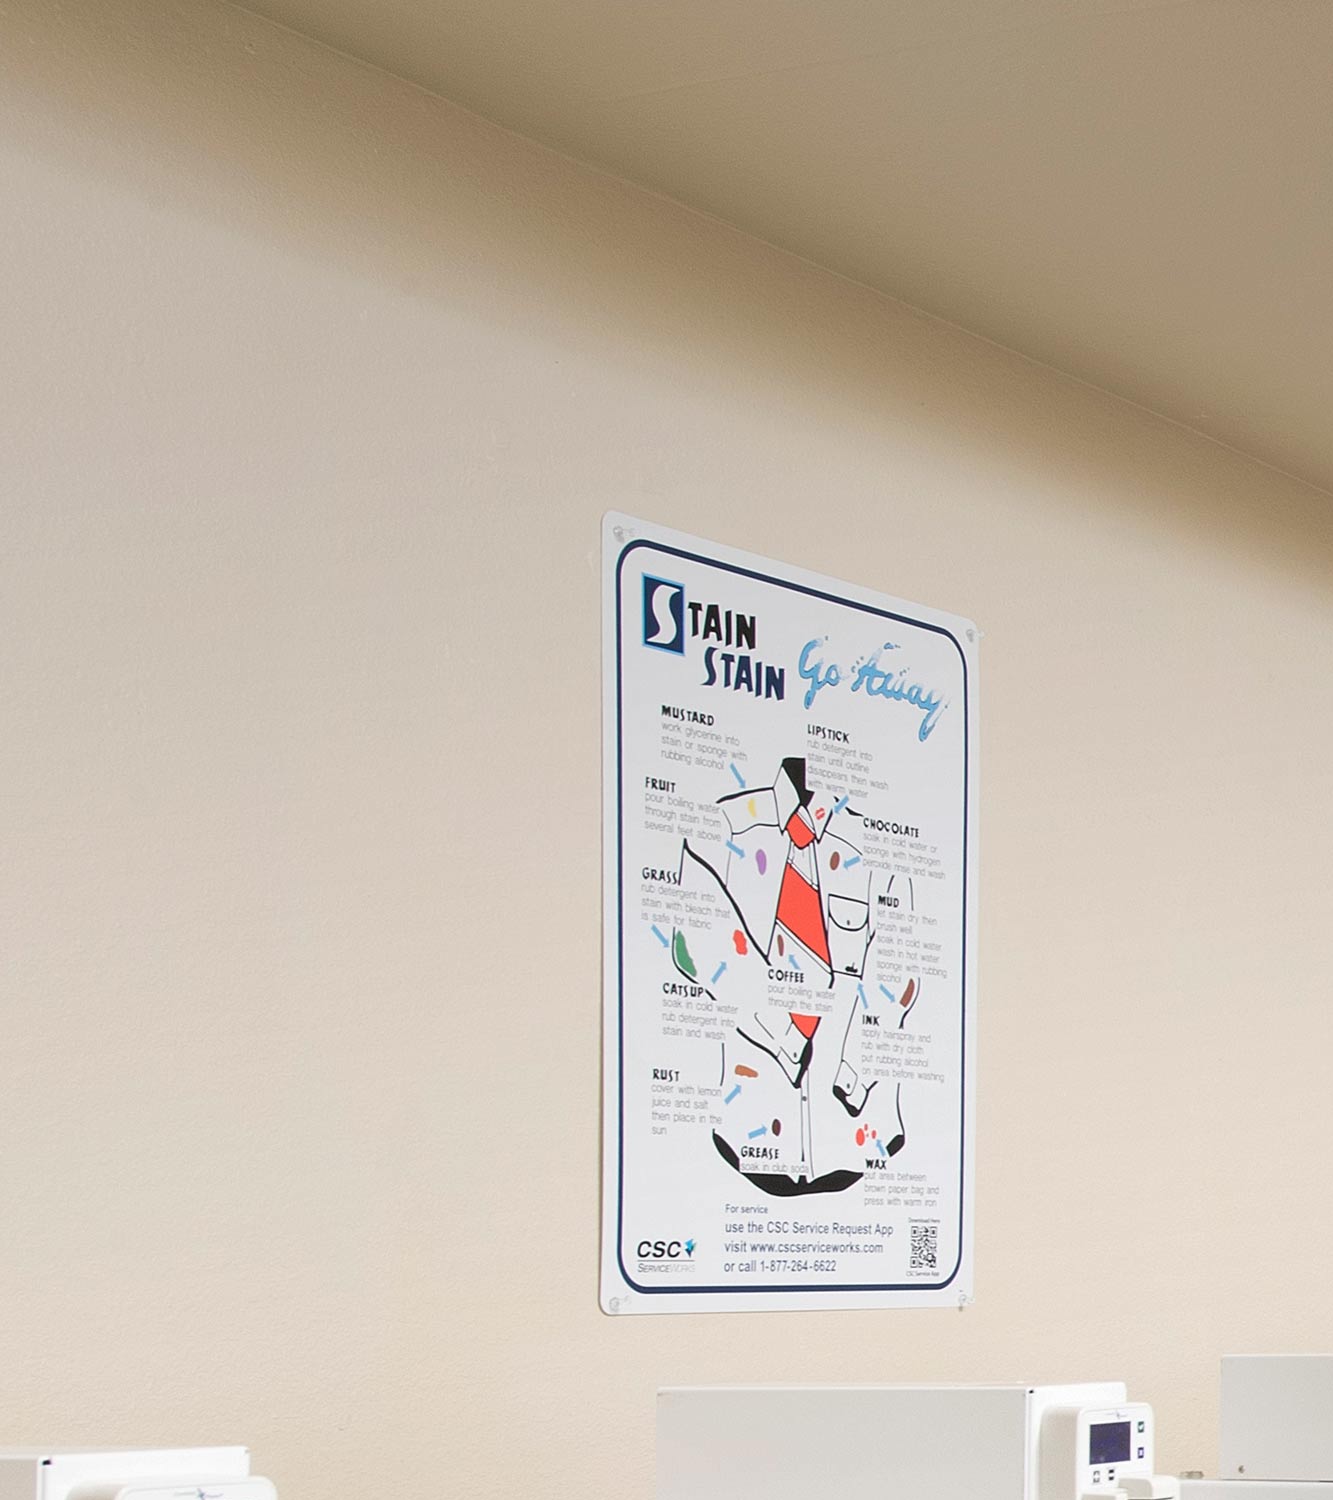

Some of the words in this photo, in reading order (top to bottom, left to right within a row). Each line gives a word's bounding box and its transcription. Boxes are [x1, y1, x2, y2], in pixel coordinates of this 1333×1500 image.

[641, 572, 757, 656] STAIN
[701, 646, 785, 701] STAIN
[799, 636, 842, 710] Go
[851, 641, 951, 743] Away
[661, 704, 715, 727] MUSTARD
[661, 722, 682, 734] work
[685, 726, 722, 743] glycerine
[725, 735, 740, 746] into
[807, 724, 850, 744] LIPSTICK
[661, 735, 682, 747] stain
[697, 743, 727, 759] sponge
[731, 750, 748, 761] with
[807, 739, 820, 749] rub
[822, 742, 857, 759] detergent
[860, 751, 873, 761] into
[660, 749, 692, 766] rubbing
[695, 755, 724, 770] alcohol
[807, 752, 825, 763] stain
[828, 757, 843, 768] until
[846, 760, 870, 774] outline
[645, 776, 676, 793] FRUIT
[807, 765, 848, 781] disappears
[851, 774, 867, 786] then
[870, 780, 889, 790] wash
[644, 793, 664, 804] pour
[667, 795, 695, 812] boiling
[697, 803, 720, 814] water
[644, 805, 677, 821] through
[680, 813, 700, 824] stain
[702, 815, 721, 828] from
[644, 820, 674, 834] several
[697, 830, 721, 842] above
[863, 817, 919, 838] CHOCOLATE
[642, 867, 677, 884] GRASS
[641, 883, 655, 894] rub
[658, 885, 698, 901] detergent
[701, 893, 715, 903] into
[641, 897, 661, 908] stain
[665, 900, 682, 911] with
[685, 903, 712, 915] bleach
[878, 895, 899, 908] MUD
[689, 917, 712, 930] fabric
[768, 969, 804, 983] COFFEE
[663, 982, 704, 997] CATSUP
[768, 984, 785, 994] pour
[788, 985, 813, 997] boiling
[815, 990, 836, 1000] water
[662, 998, 682, 1008] soak
[696, 1001, 713, 1012] cold
[716, 1004, 739, 1014] water
[768, 997, 797, 1010] through
[800, 1000, 812, 1010] the
[815, 1002, 832, 1012] stain
[662, 1012, 676, 1022] rub
[679, 1013, 717, 1027] detergent
[720, 1018, 735, 1028] into
[862, 1014, 880, 1026] INK
[662, 1025, 682, 1036] stain
[685, 1028, 701, 1038] and
[705, 1030, 725, 1040] wash
[652, 1068, 680, 1082] RUST
[651, 1084, 674, 1093] cover
[679, 1085, 695, 1095] with
[698, 1086, 722, 1097] lemon
[651, 1098, 672, 1108] juice
[675, 1099, 690, 1109] and
[694, 1100, 708, 1110] salt
[652, 1111, 670, 1121] then
[673, 1112, 695, 1124] place
[710, 1114, 722, 1125] the
[652, 1125, 667, 1135] sun
[741, 1146, 779, 1160] GREASE
[741, 1163, 760, 1171] soak
[772, 1163, 789, 1173] club
[791, 1164, 809, 1174] soda
[865, 1158, 886, 1170] WAX
[725, 1204, 739, 1214] For
[741, 1205, 768, 1214] service
[725, 1223, 744, 1233] use
[747, 1221, 763, 1233] the
[766, 1222, 790, 1234] CSC
[793, 1222, 829, 1234] Service
[832, 1223, 872, 1236] Request
[874, 1224, 893, 1236] App
[637, 1241, 681, 1258] CSC
[725, 1241, 746, 1253] visit
[750, 1242, 884, 1254] www.cscserviceworks.com
[724, 1262, 735, 1273] or
[739, 1260, 756, 1273] call
[760, 1261, 836, 1273] 1-877-264-6622
